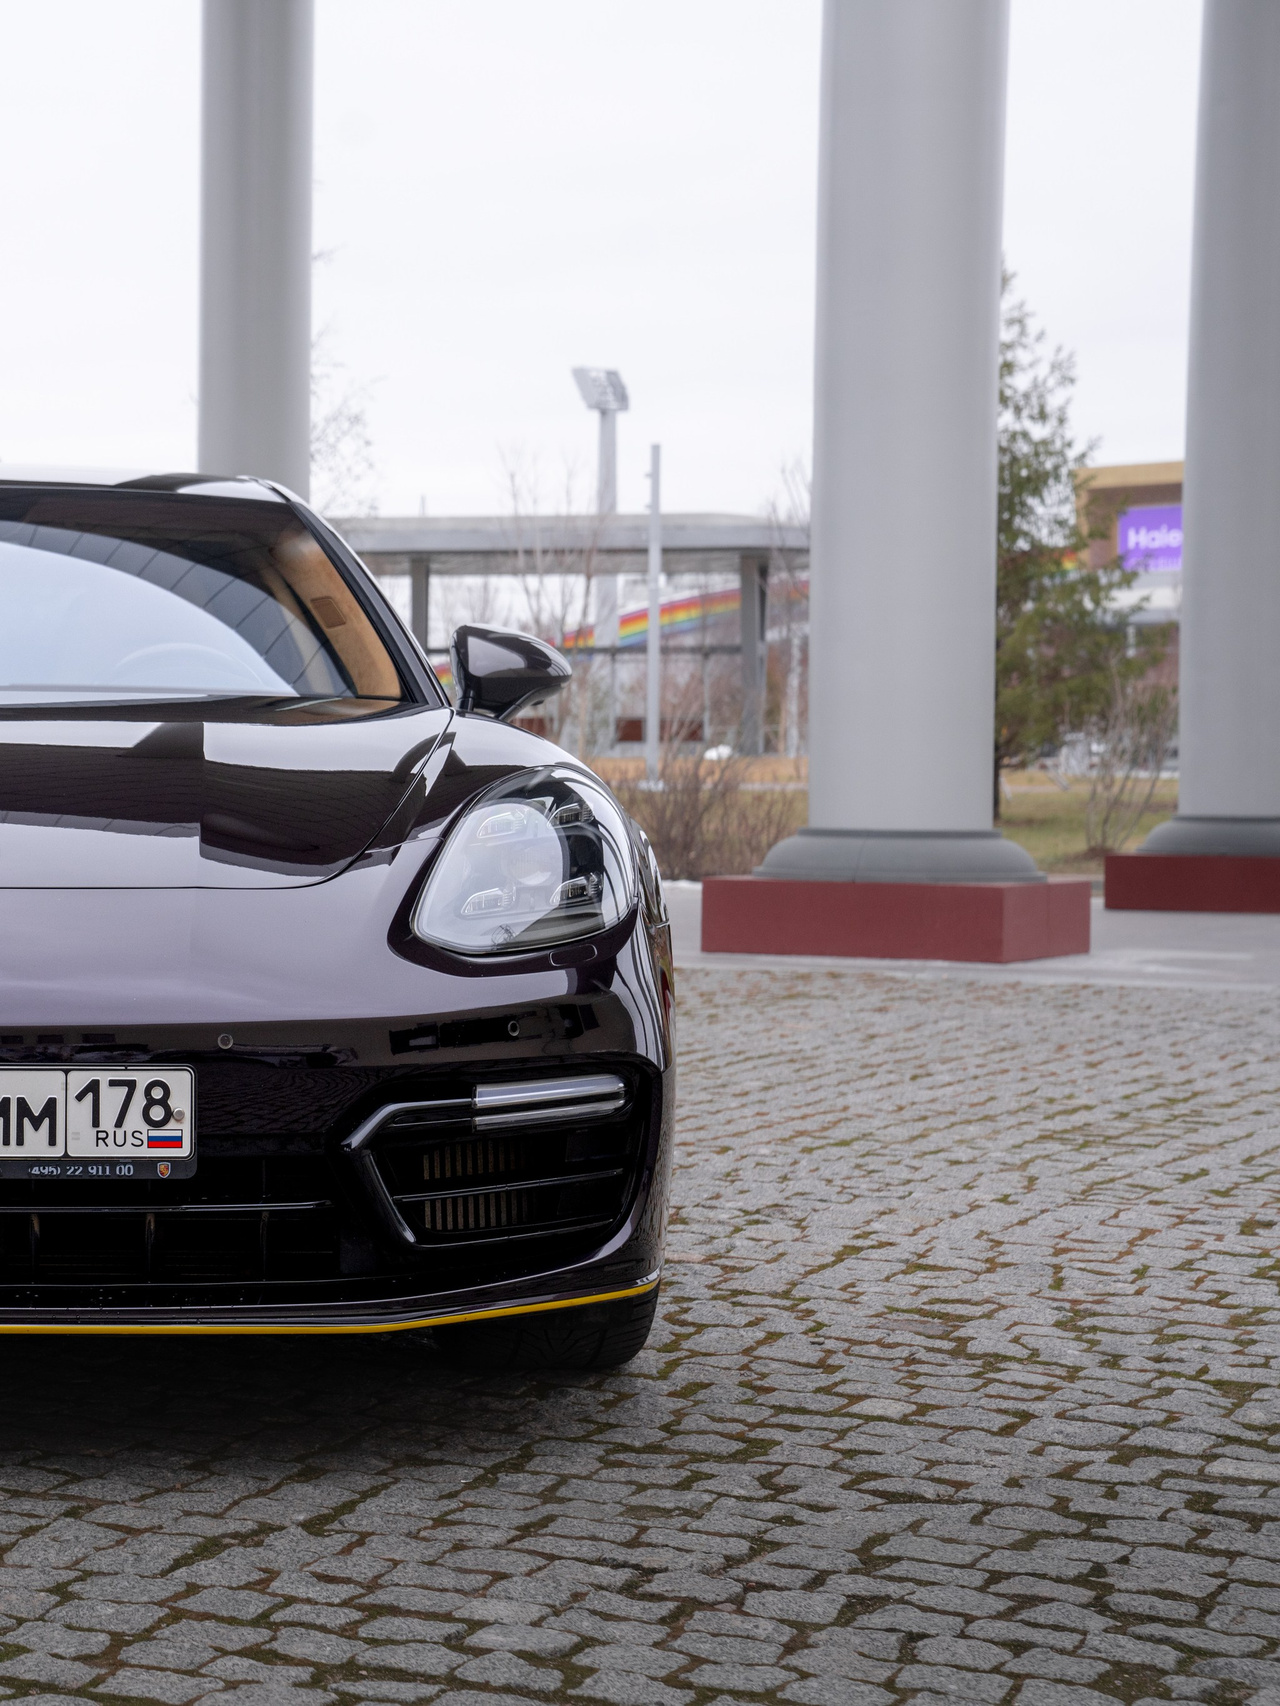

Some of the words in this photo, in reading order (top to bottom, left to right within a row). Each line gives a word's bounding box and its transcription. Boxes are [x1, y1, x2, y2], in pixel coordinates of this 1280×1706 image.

[74, 1078, 172, 1128] 178
[95, 1130, 144, 1147] RUS
[66, 1165, 83, 1176] 22
[88, 1165, 111, 1176] 911
[116, 1164, 134, 1176] 00
